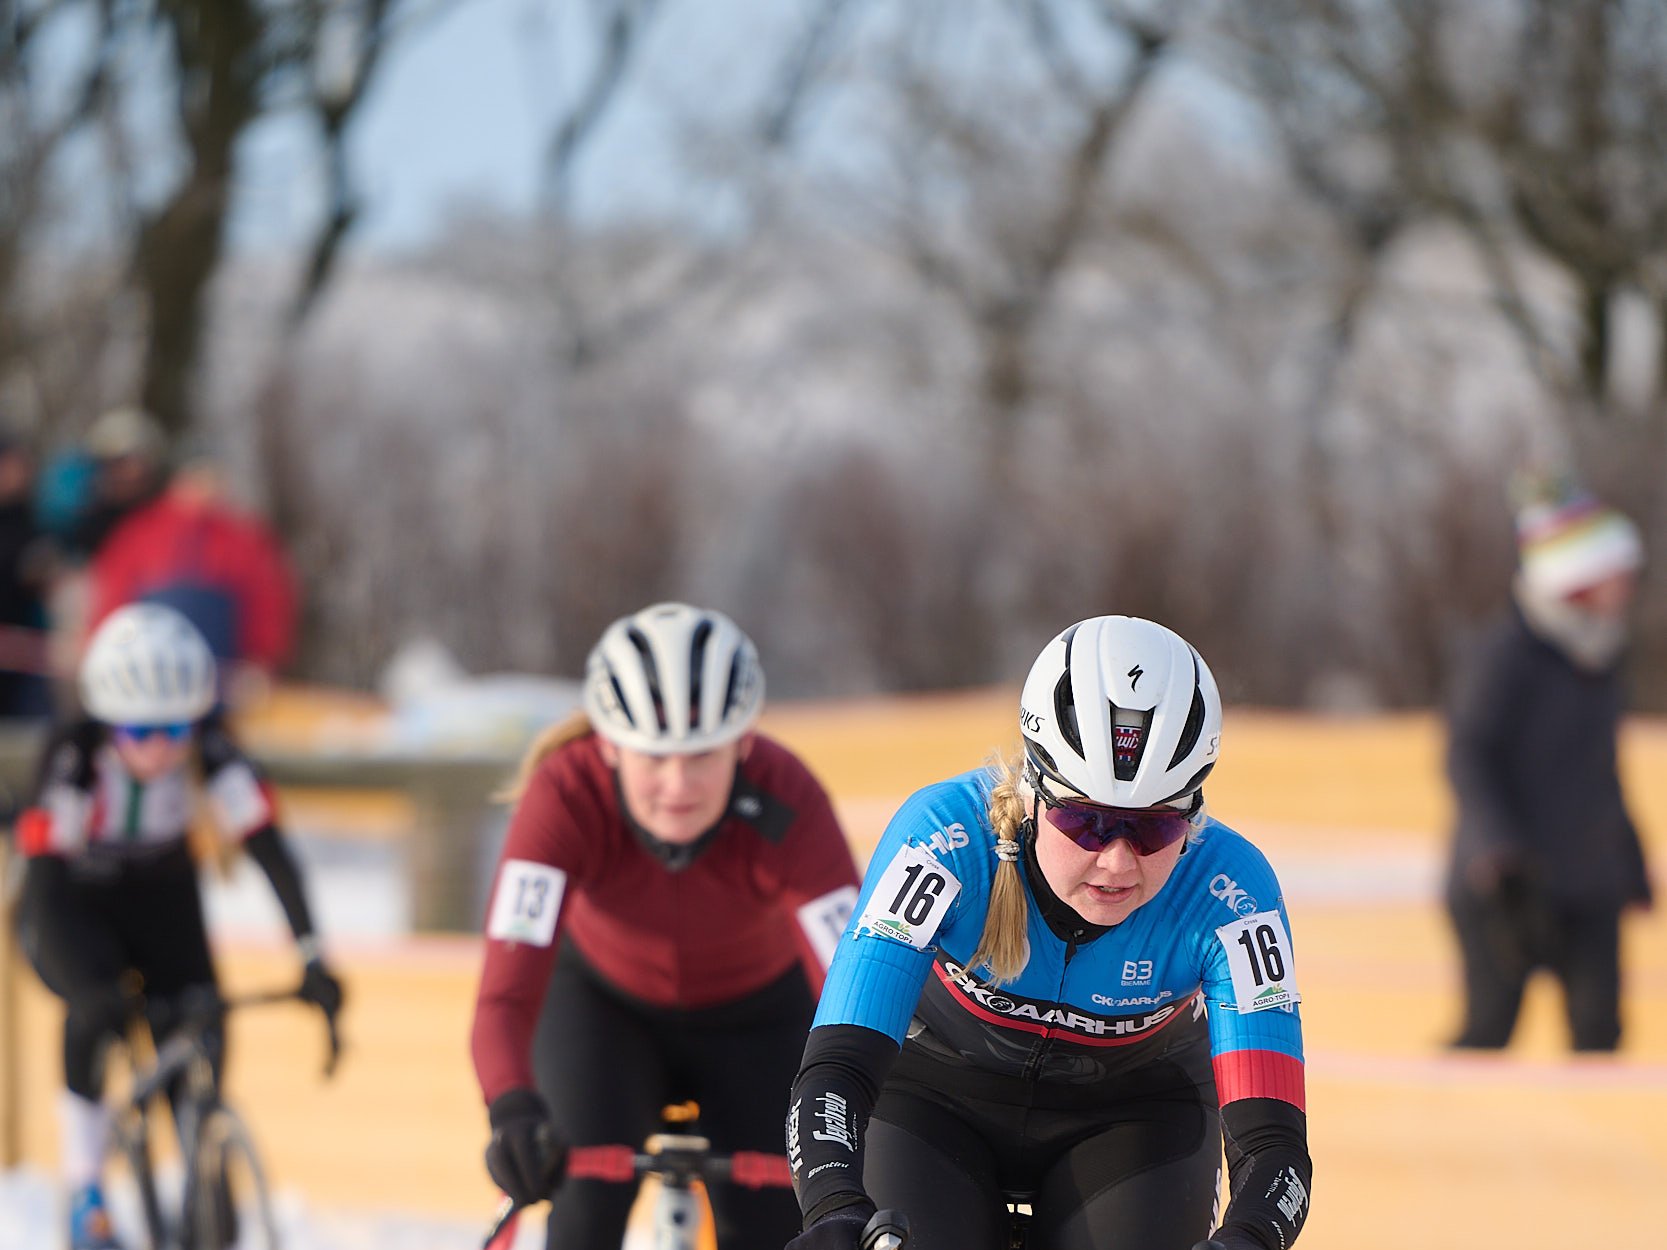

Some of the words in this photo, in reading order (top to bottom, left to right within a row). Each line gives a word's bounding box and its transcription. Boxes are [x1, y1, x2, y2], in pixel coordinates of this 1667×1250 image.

[513, 875, 550, 919] 13
[888, 863, 946, 927] 16
[1237, 924, 1286, 987] 16
